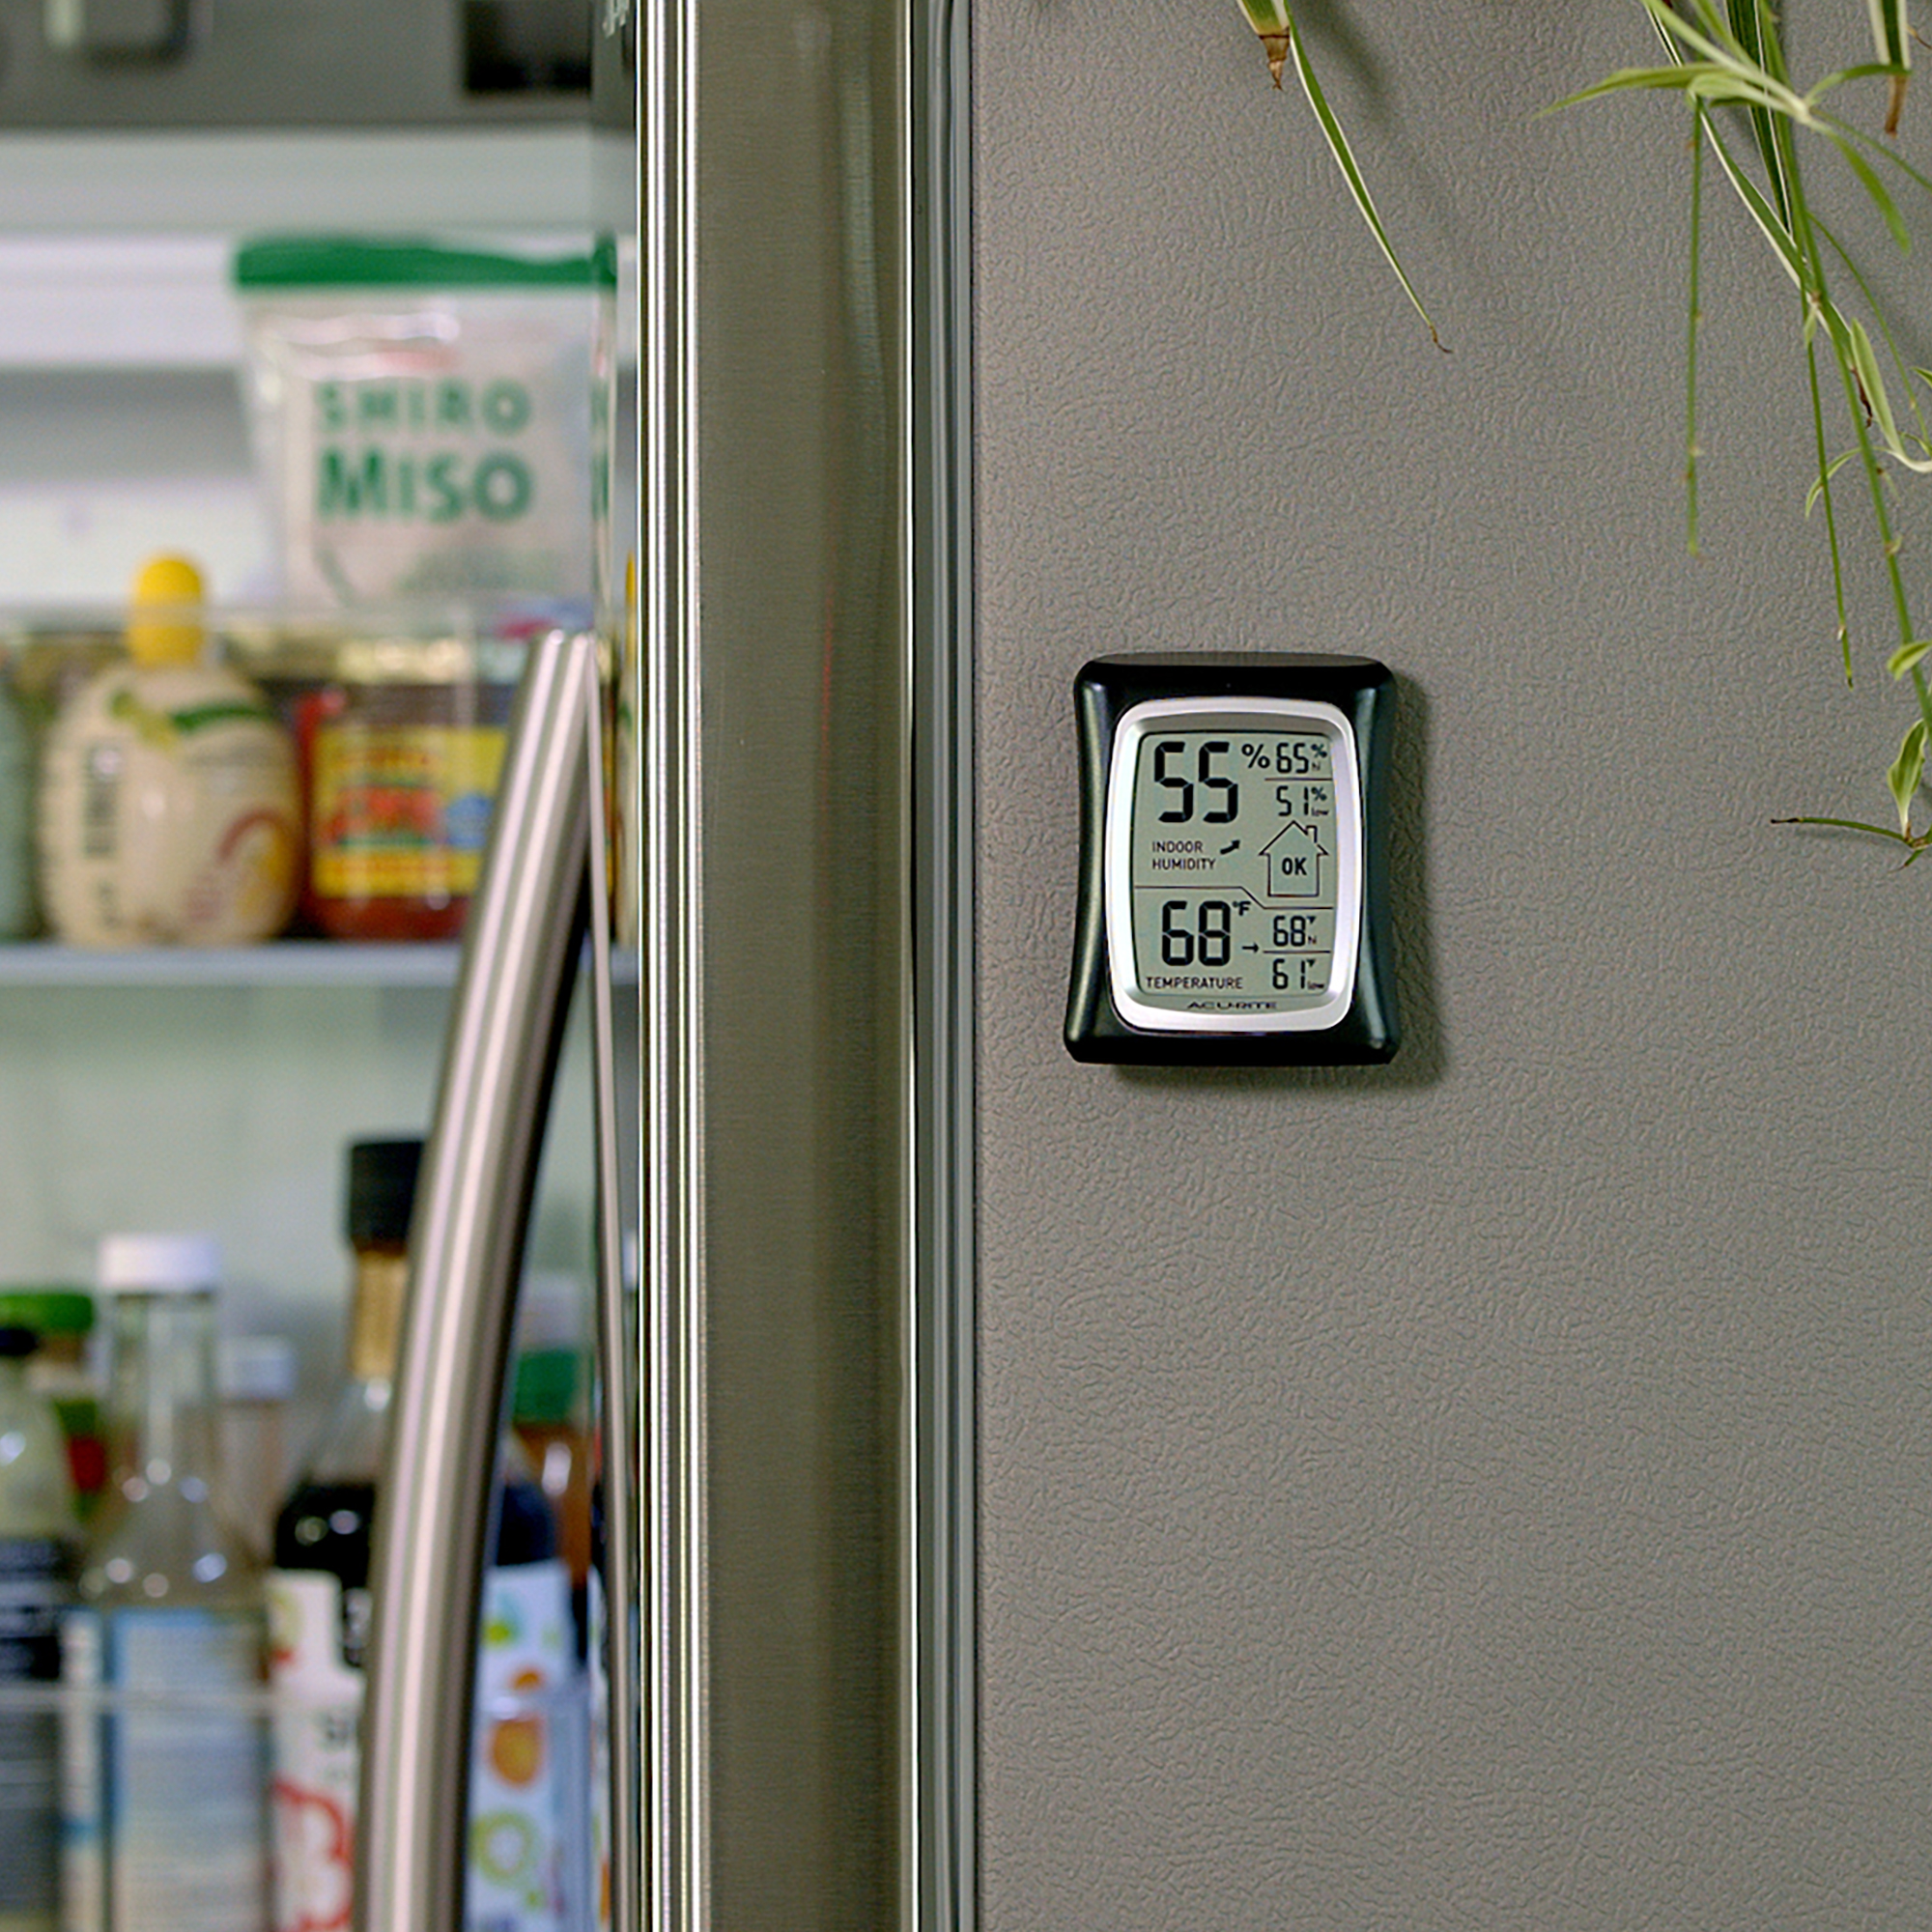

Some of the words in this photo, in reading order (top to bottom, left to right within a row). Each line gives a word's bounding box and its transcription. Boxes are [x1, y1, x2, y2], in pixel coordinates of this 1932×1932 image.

[314, 378, 533, 435] SHIRO
[317, 447, 535, 524] MISO
[1151, 839, 1204, 854] INDOOR
[1151, 857, 1216, 870] HUMIDITY
[1281, 857, 1308, 876] OK
[1146, 976, 1244, 990] TEMPERATURE
